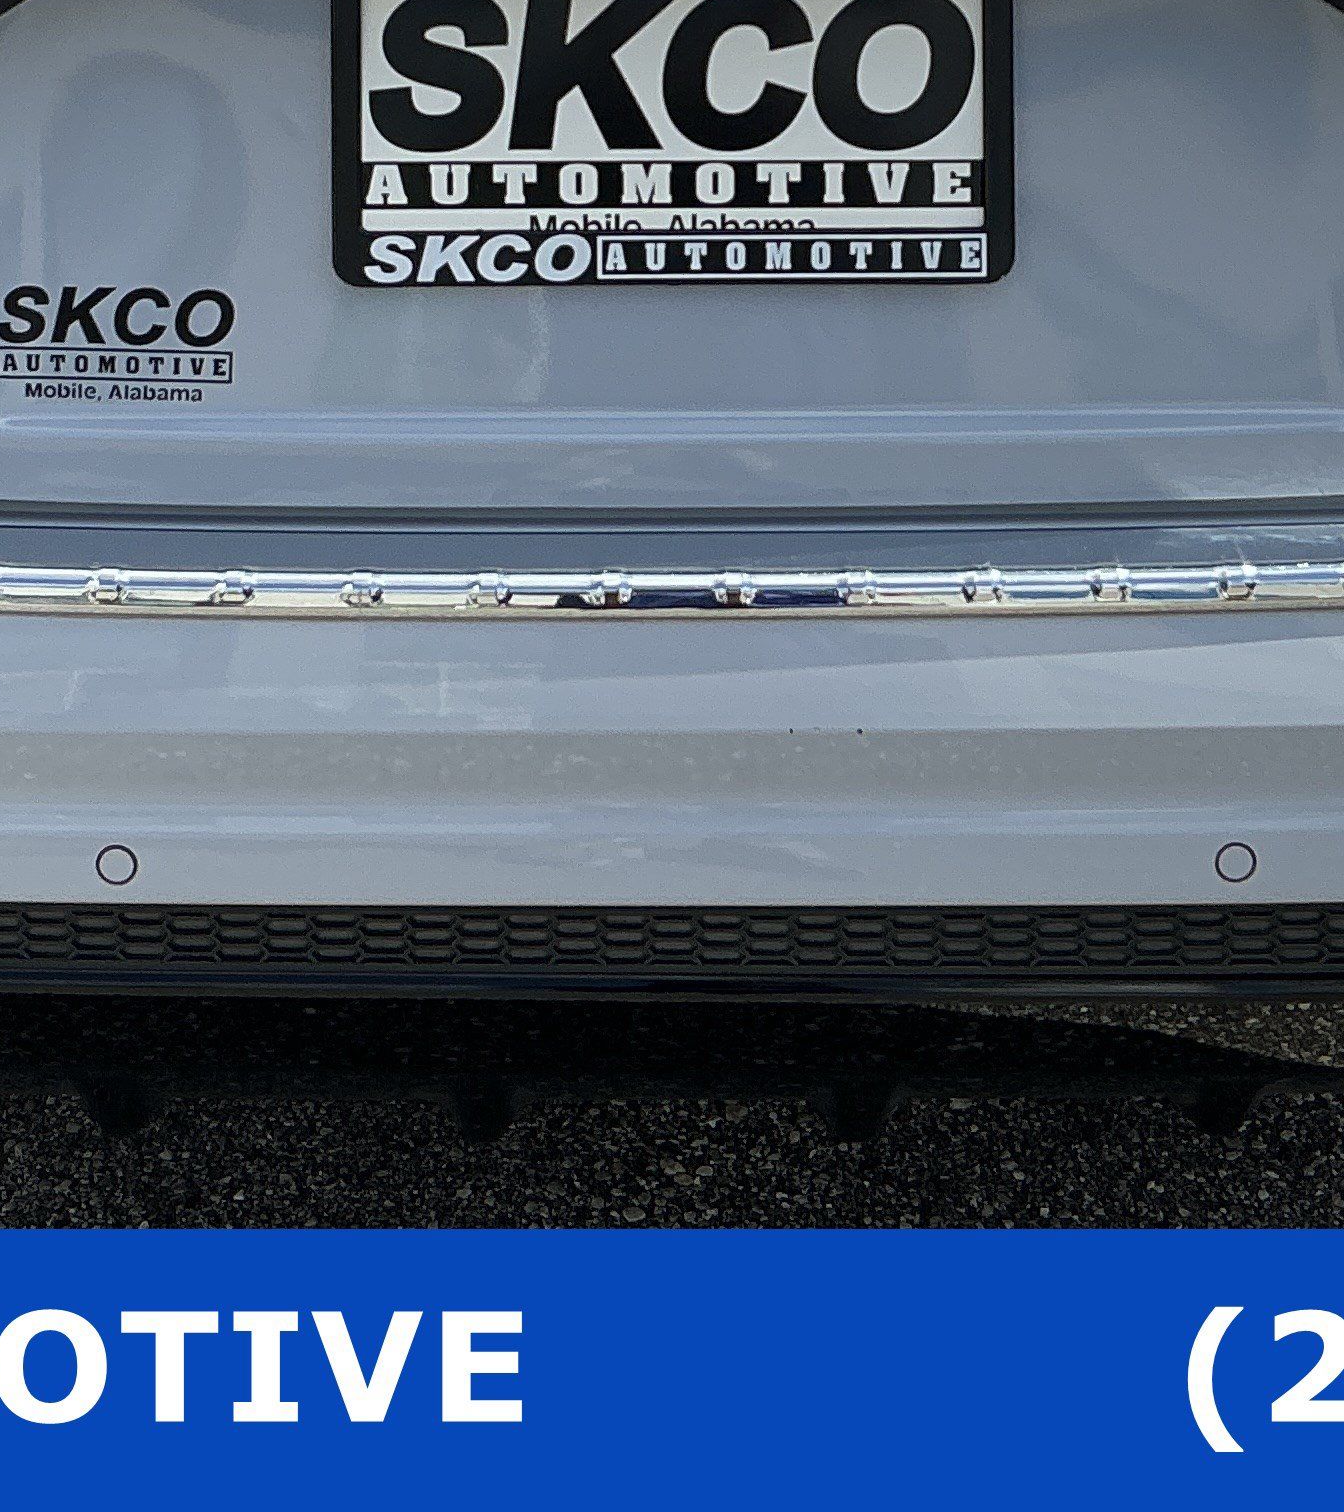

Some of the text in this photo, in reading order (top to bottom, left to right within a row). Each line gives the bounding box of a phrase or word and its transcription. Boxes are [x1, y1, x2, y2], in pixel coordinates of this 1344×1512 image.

[365, 163, 972, 206] AUTOMOTIVE
[364, 233, 593, 284] SKCO
[605, 240, 982, 272] AUTOMOTIVE
[2, 352, 228, 377] AUTOMOTIVE
[24, 382, 204, 403] Mobile, Alabama
